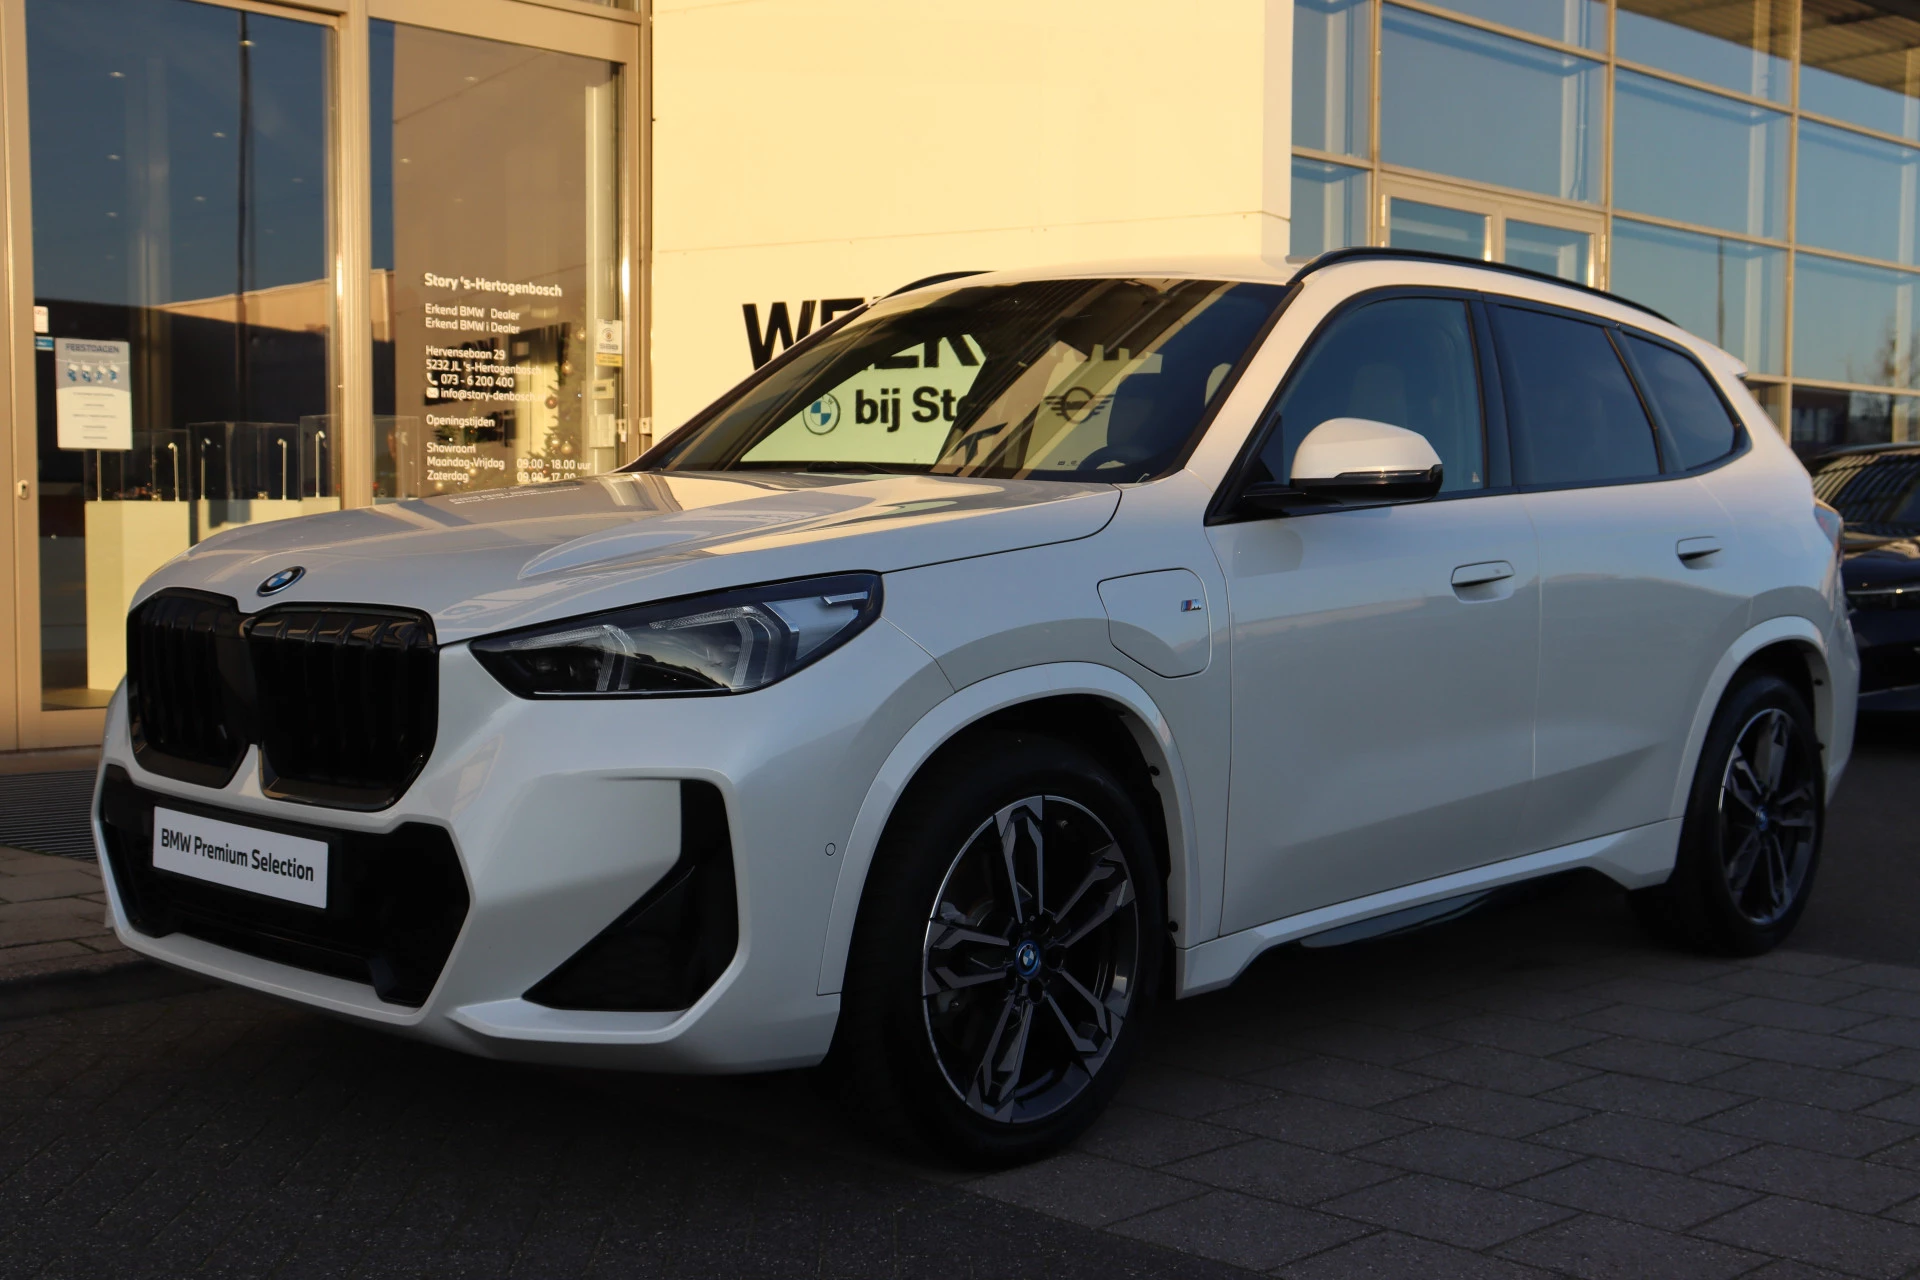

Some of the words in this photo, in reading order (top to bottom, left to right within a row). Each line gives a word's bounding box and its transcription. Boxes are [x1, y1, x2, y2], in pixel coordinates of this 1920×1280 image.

[424, 272, 458, 291] Story
[460, 276, 563, 297] 's-Hertogenbosch
[425, 303, 458, 316] Erkend
[460, 306, 485, 318] BMW
[490, 308, 520, 320] Dealer
[425, 317, 458, 330] Erkend
[460, 320, 485, 331] BMW
[486, 321, 489, 332] i
[491, 322, 520, 334] Dealer
[426, 345, 492, 359] Hervensebaan
[493, 349, 506, 360] 29
[426, 359, 449, 371] 5232
[451, 360, 462, 372] JL
[440, 373, 459, 385] 073
[467, 375, 474, 386] 6
[475, 376, 494, 387] 200
[495, 377, 514, 388] 400
[855, 388, 901, 433] bij
[426, 414, 495, 429] Openingstijden
[426, 442, 476, 454] Showroom
[551, 459, 575, 470] 18.00
[577, 462, 591, 470] uur
[427, 470, 469, 483] Zaterdag
[161, 828, 191, 853] BMW
[194, 836, 248, 867] Premium
[252, 849, 314, 882] Selection
